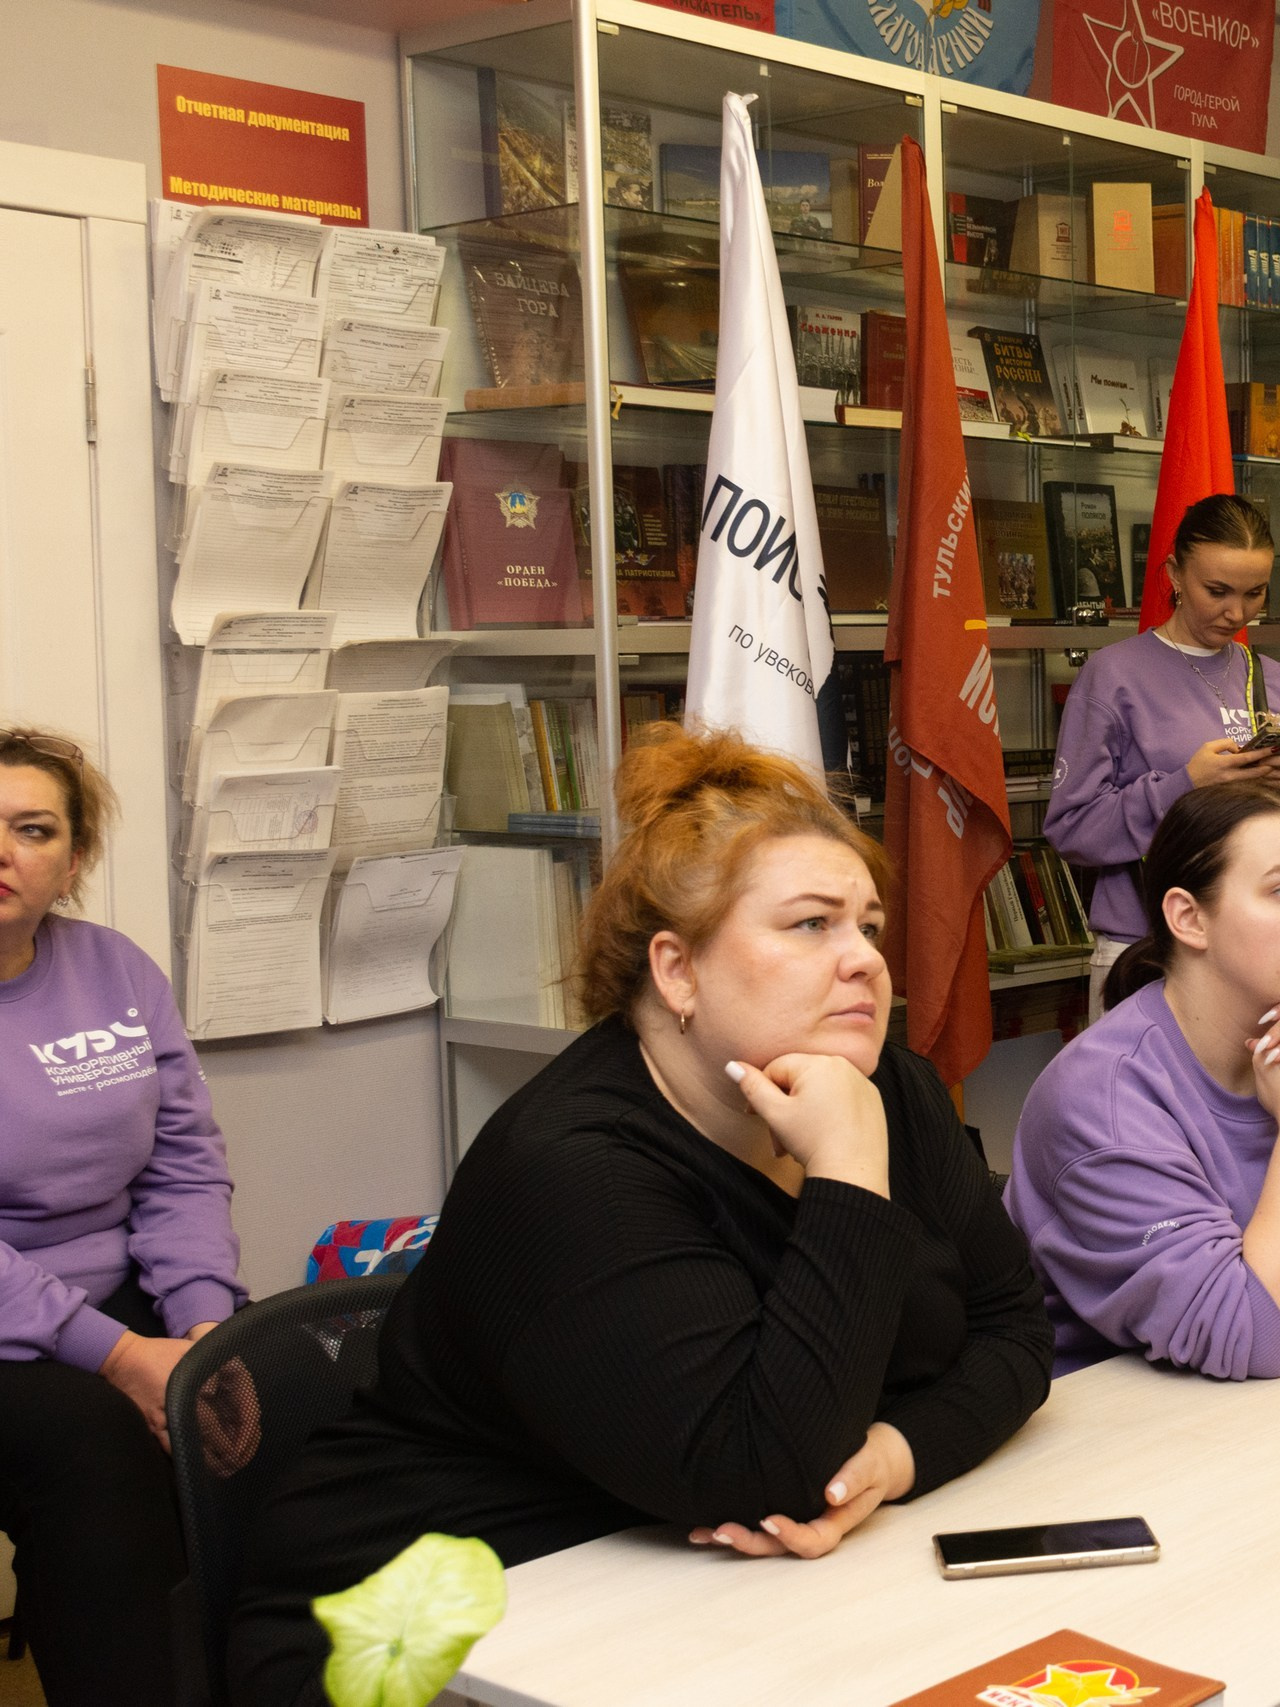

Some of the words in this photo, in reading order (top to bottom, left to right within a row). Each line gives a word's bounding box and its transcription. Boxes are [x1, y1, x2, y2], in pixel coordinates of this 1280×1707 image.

[1151, 1, 1260, 50] «ВОЕНКОР»
[1173, 84, 1241, 112] ГОРОД-ГЕРОЙ
[175, 95, 245, 124] Отчетная
[247, 110, 350, 142] документация
[1190, 111, 1218, 129] ТУЛА
[169, 175, 280, 209] Методические
[281, 193, 362, 221] материалы
[517, 298, 559, 318] ГОРА
[994, 343, 1034, 360] БИТВЫ
[506, 565, 545, 576] ОРДЕН
[497, 577, 558, 589] «ПОБЕДА»
[728, 624, 753, 649] по
[754, 643, 817, 703] увеков
[51, 1058, 140, 1086] УНИВЕРСИТЕТ
[57, 1086, 87, 1097] вместе
